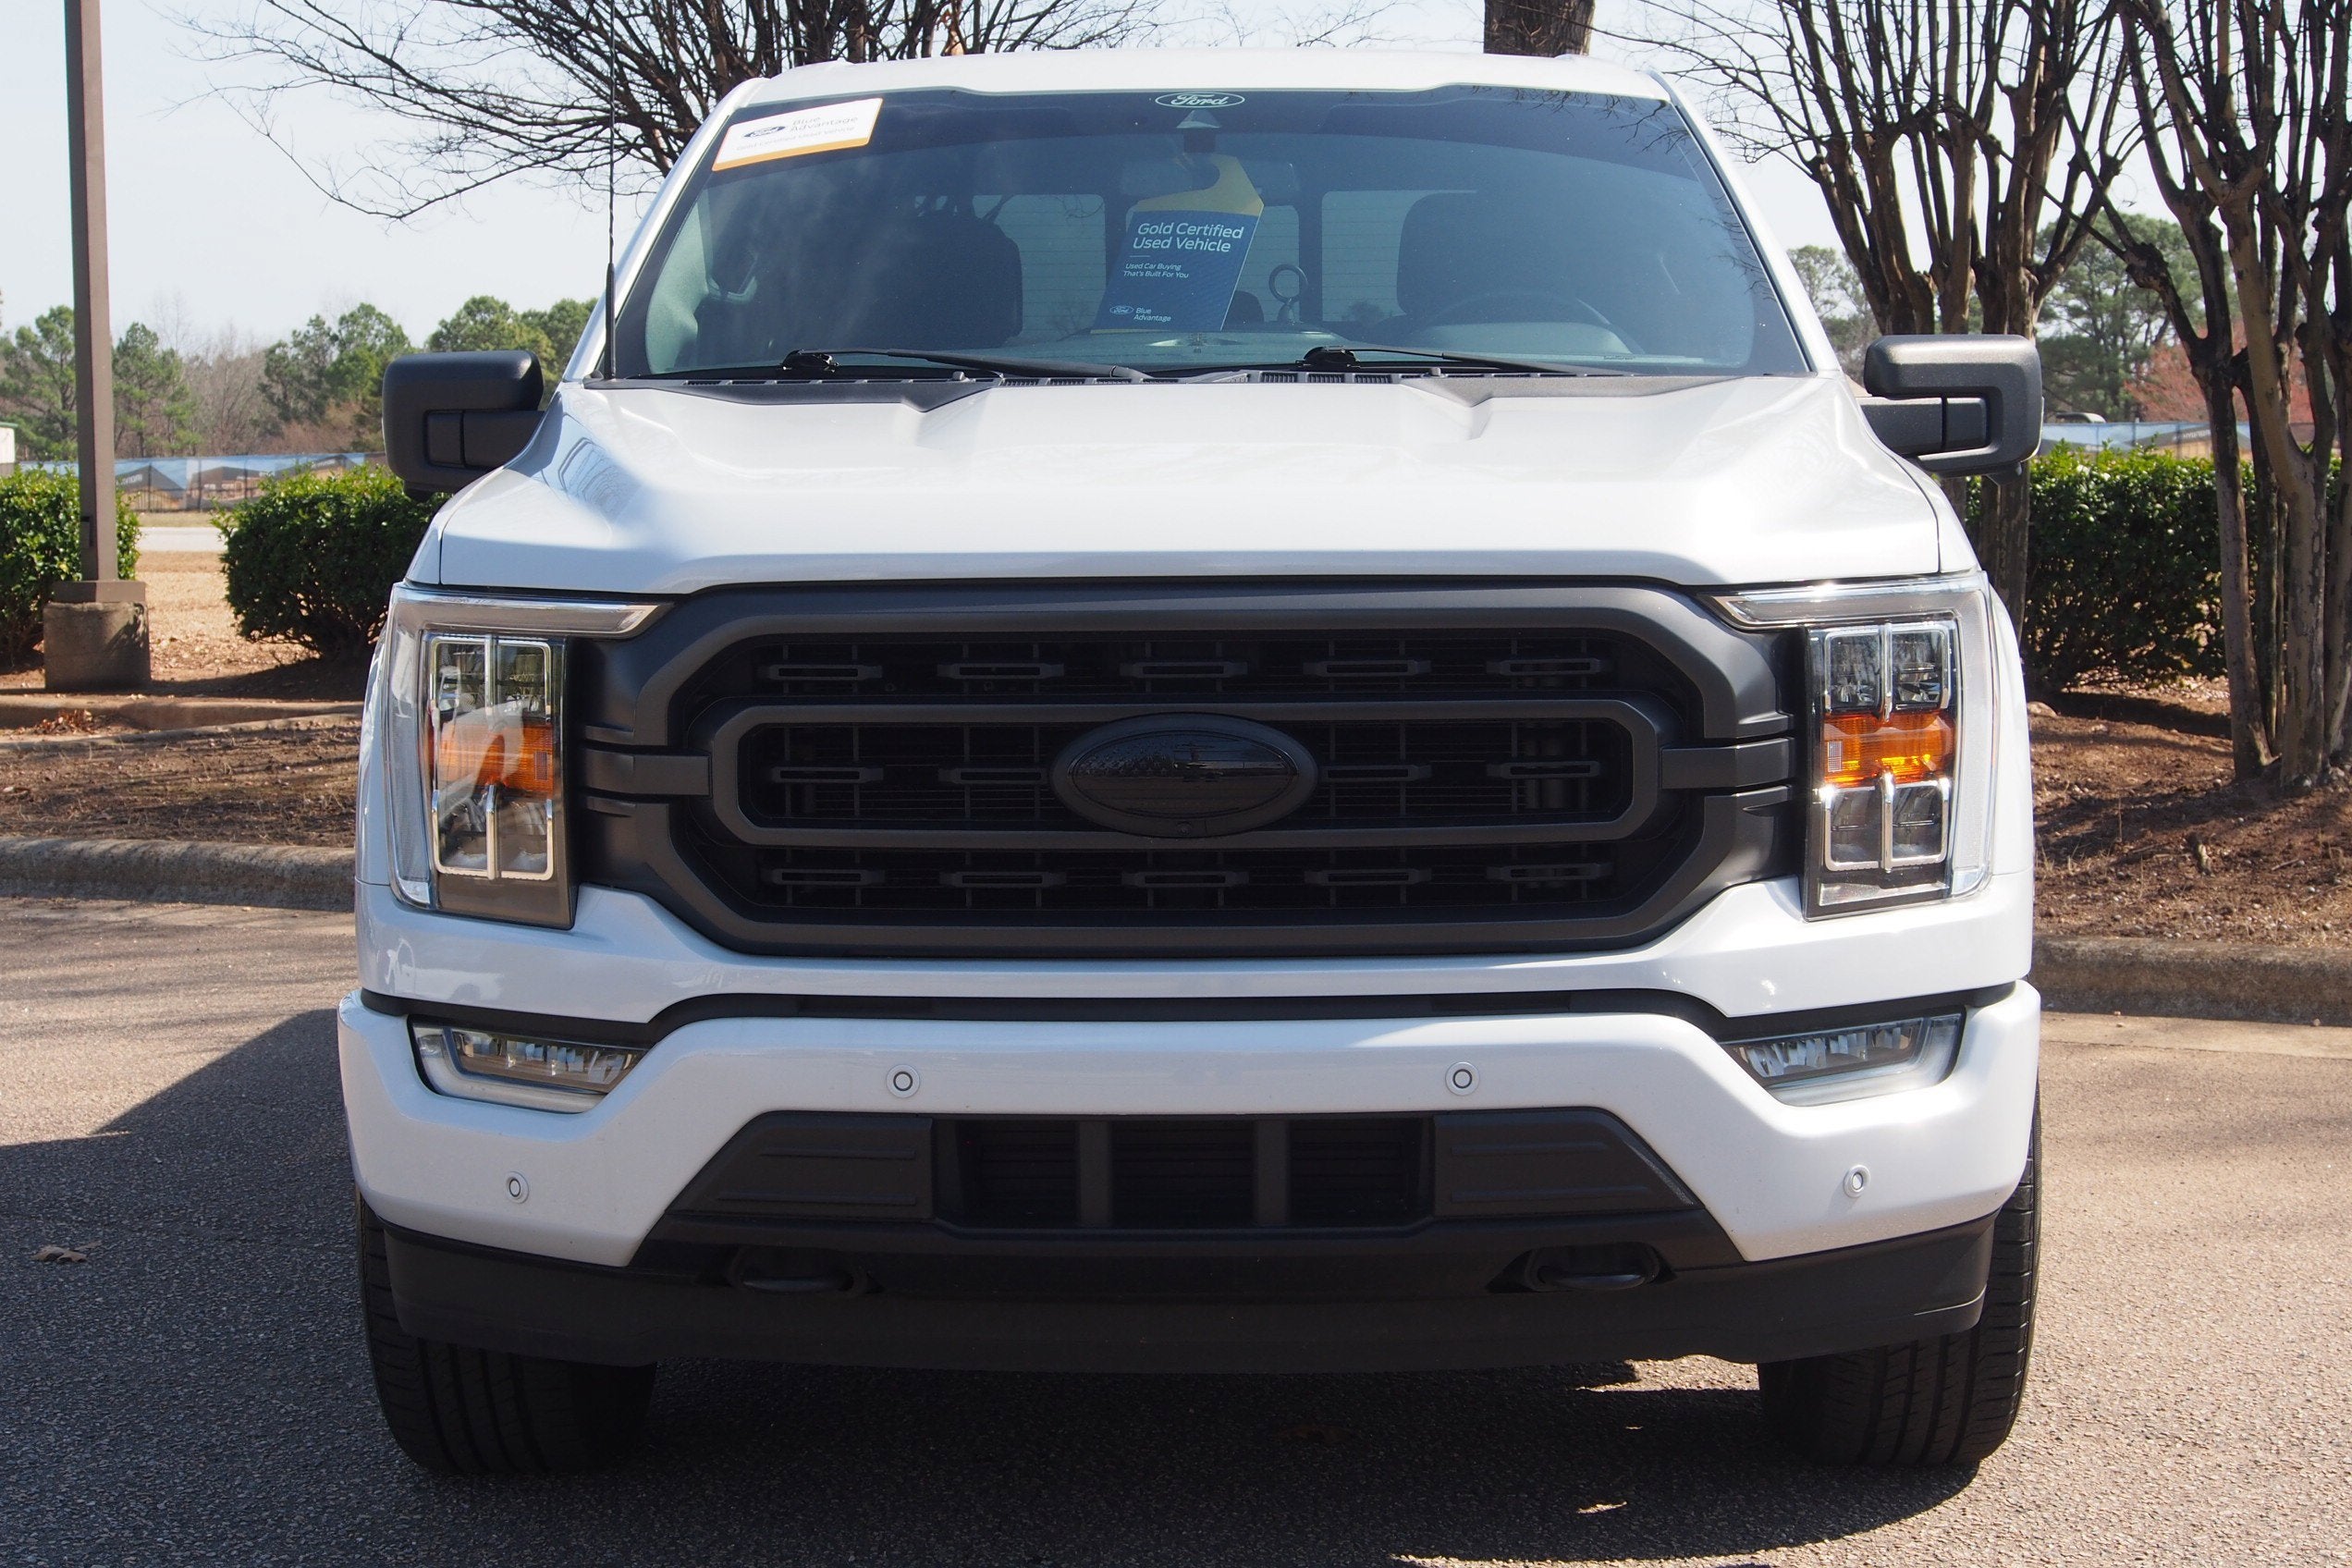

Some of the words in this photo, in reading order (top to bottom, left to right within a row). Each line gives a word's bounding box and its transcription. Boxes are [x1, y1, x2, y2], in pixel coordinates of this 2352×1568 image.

[1170, 93, 1230, 105] Ford
[1138, 222, 1174, 235] Gold
[1176, 223, 1244, 239] Certified
[1133, 237, 1172, 249] Used
[1176, 238, 1231, 252] Vehicle
[1133, 314, 1171, 323] Advantage
